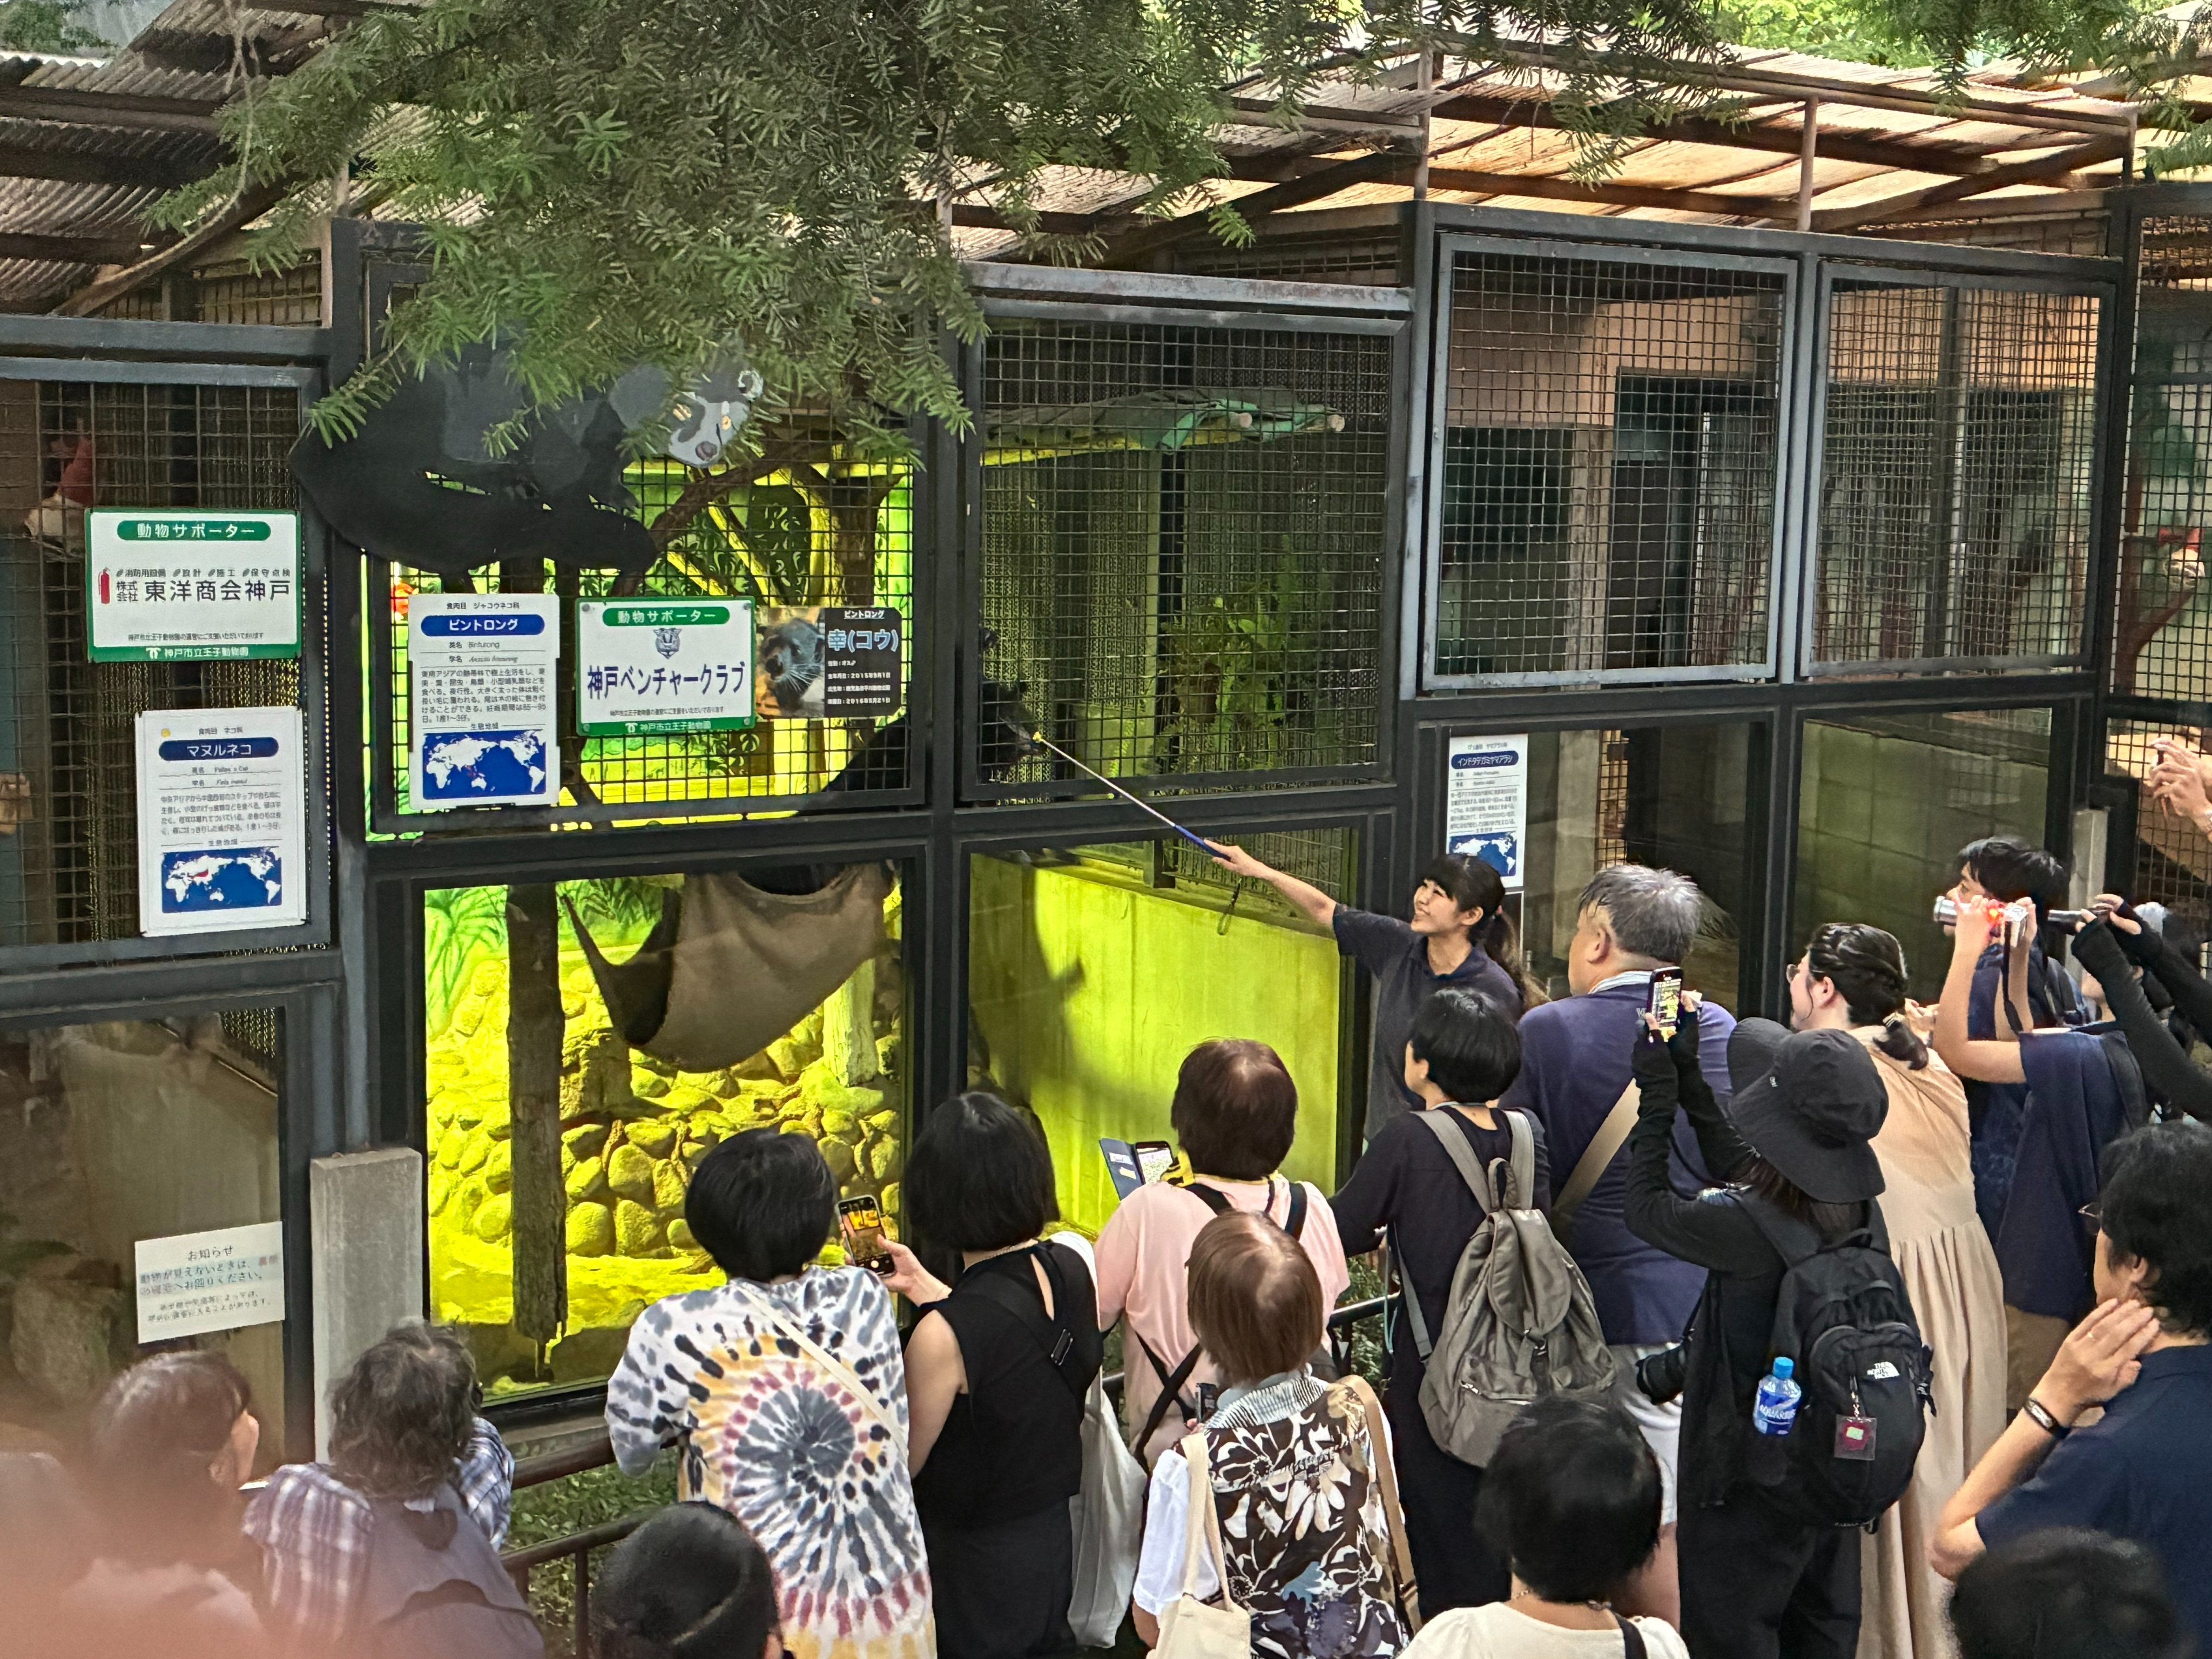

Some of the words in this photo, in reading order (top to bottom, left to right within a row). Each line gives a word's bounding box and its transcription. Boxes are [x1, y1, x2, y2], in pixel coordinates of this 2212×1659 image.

[137, 523, 255, 538] 動物サポーター
[182, 569, 201, 577] 設計
[251, 569, 291, 577] 保守点検
[116, 581, 138, 592] 株式
[145, 579, 291, 602] 東洋商会神戸
[116, 592, 138, 603] 会社
[618, 609, 716, 625] 動物サポーター
[844, 610, 885, 618] ビントロング
[449, 618, 518, 631] ビントロング
[827, 629, 899, 653] 幸(コウ)
[164, 647, 249, 658] 神戸市立王子動物園
[588, 661, 746, 700] 神戸ベンチャークラブ
[640, 720, 711, 732] 神戸市立王子動物園
[187, 744, 252, 757] マヌルネコ
[188, 1245, 233, 1262] お知らせ
